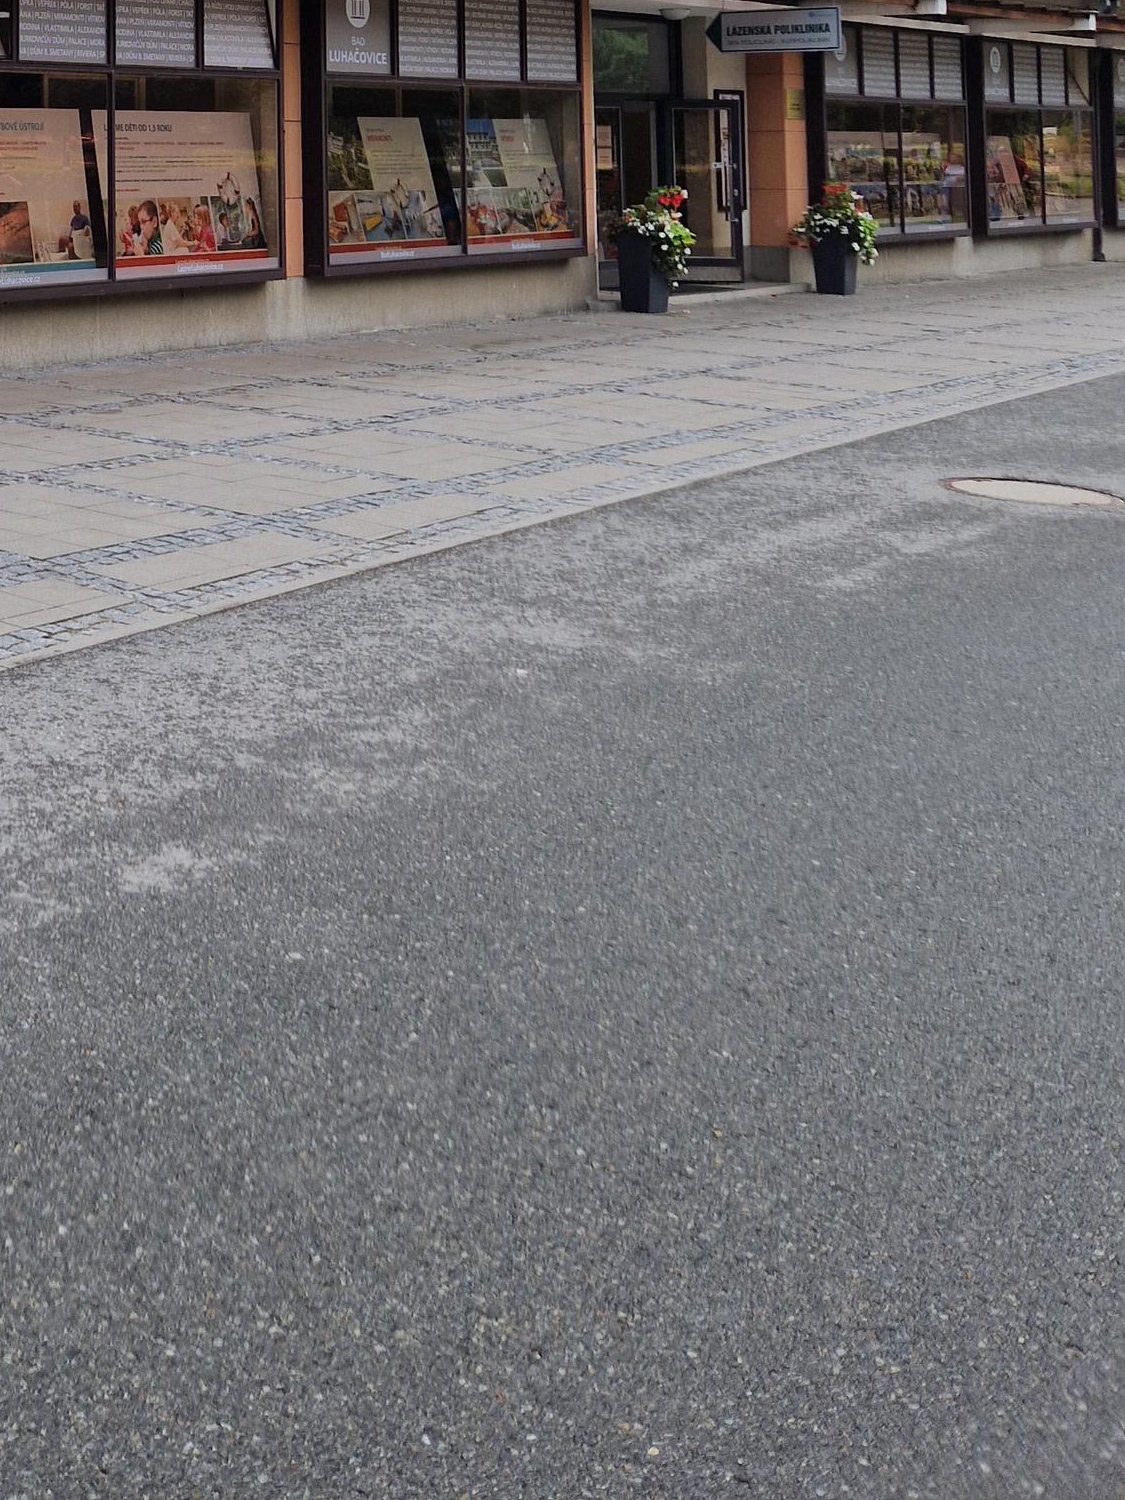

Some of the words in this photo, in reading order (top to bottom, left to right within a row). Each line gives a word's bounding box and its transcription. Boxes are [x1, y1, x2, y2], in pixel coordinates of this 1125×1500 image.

[774, 23, 831, 34] POLIKLINIKA
[352, 37, 365, 46] BAD
[329, 48, 387, 64] LUHAČOVICE
